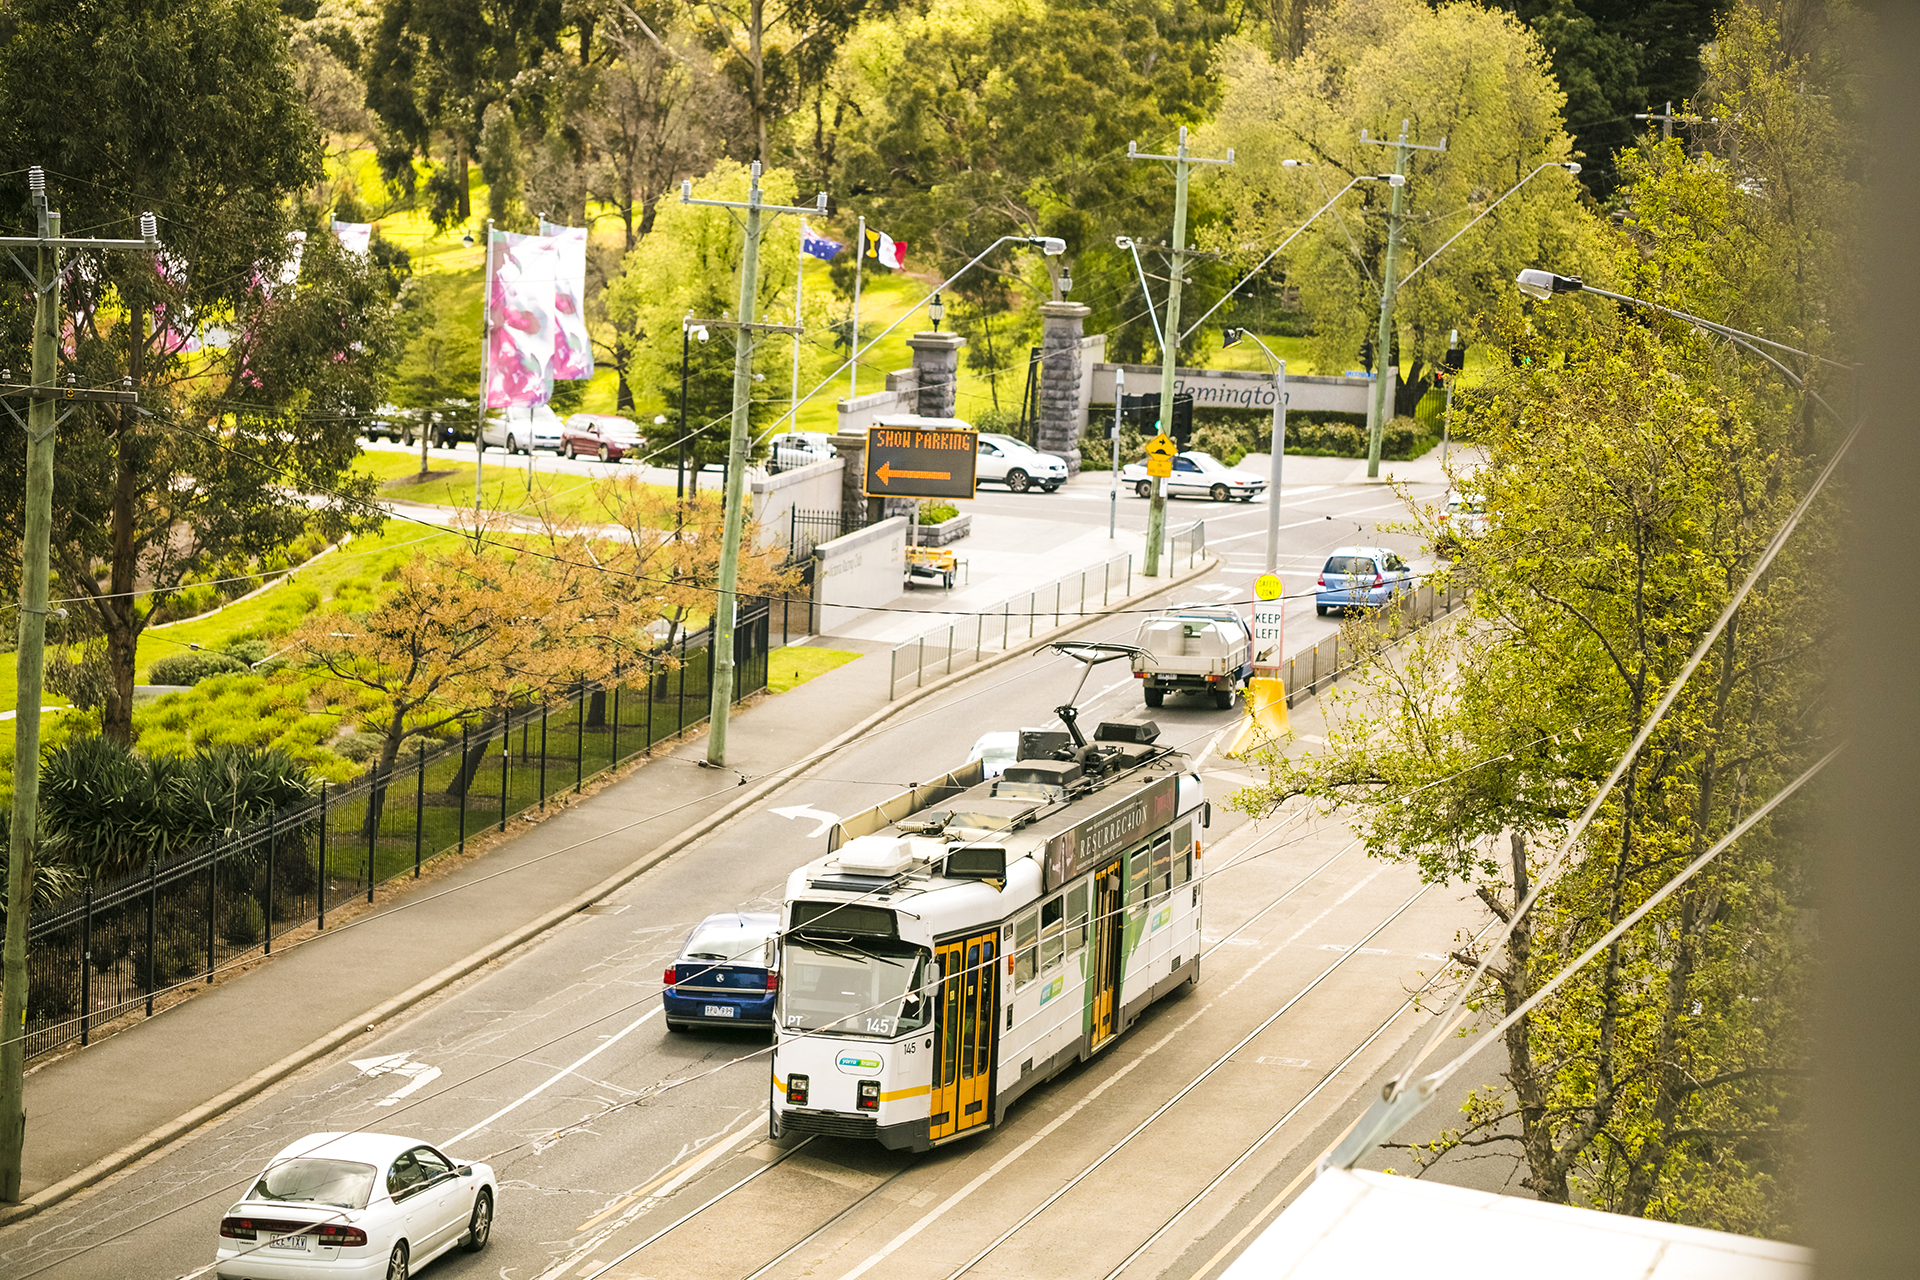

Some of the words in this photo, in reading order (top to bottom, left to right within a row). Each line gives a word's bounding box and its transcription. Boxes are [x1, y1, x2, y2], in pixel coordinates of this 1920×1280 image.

[876, 430, 911, 448] SHOW
[915, 432, 971, 451] PARKING
[1259, 580, 1279, 588] SAFETY
[1261, 589, 1276, 597] ZONE
[1255, 613, 1281, 624] KEEP
[1255, 628, 1279, 639] LEFT
[1079, 804, 1148, 859] RESURRECTION
[866, 1017, 890, 1034] 145
[903, 1042, 916, 1055] 145
